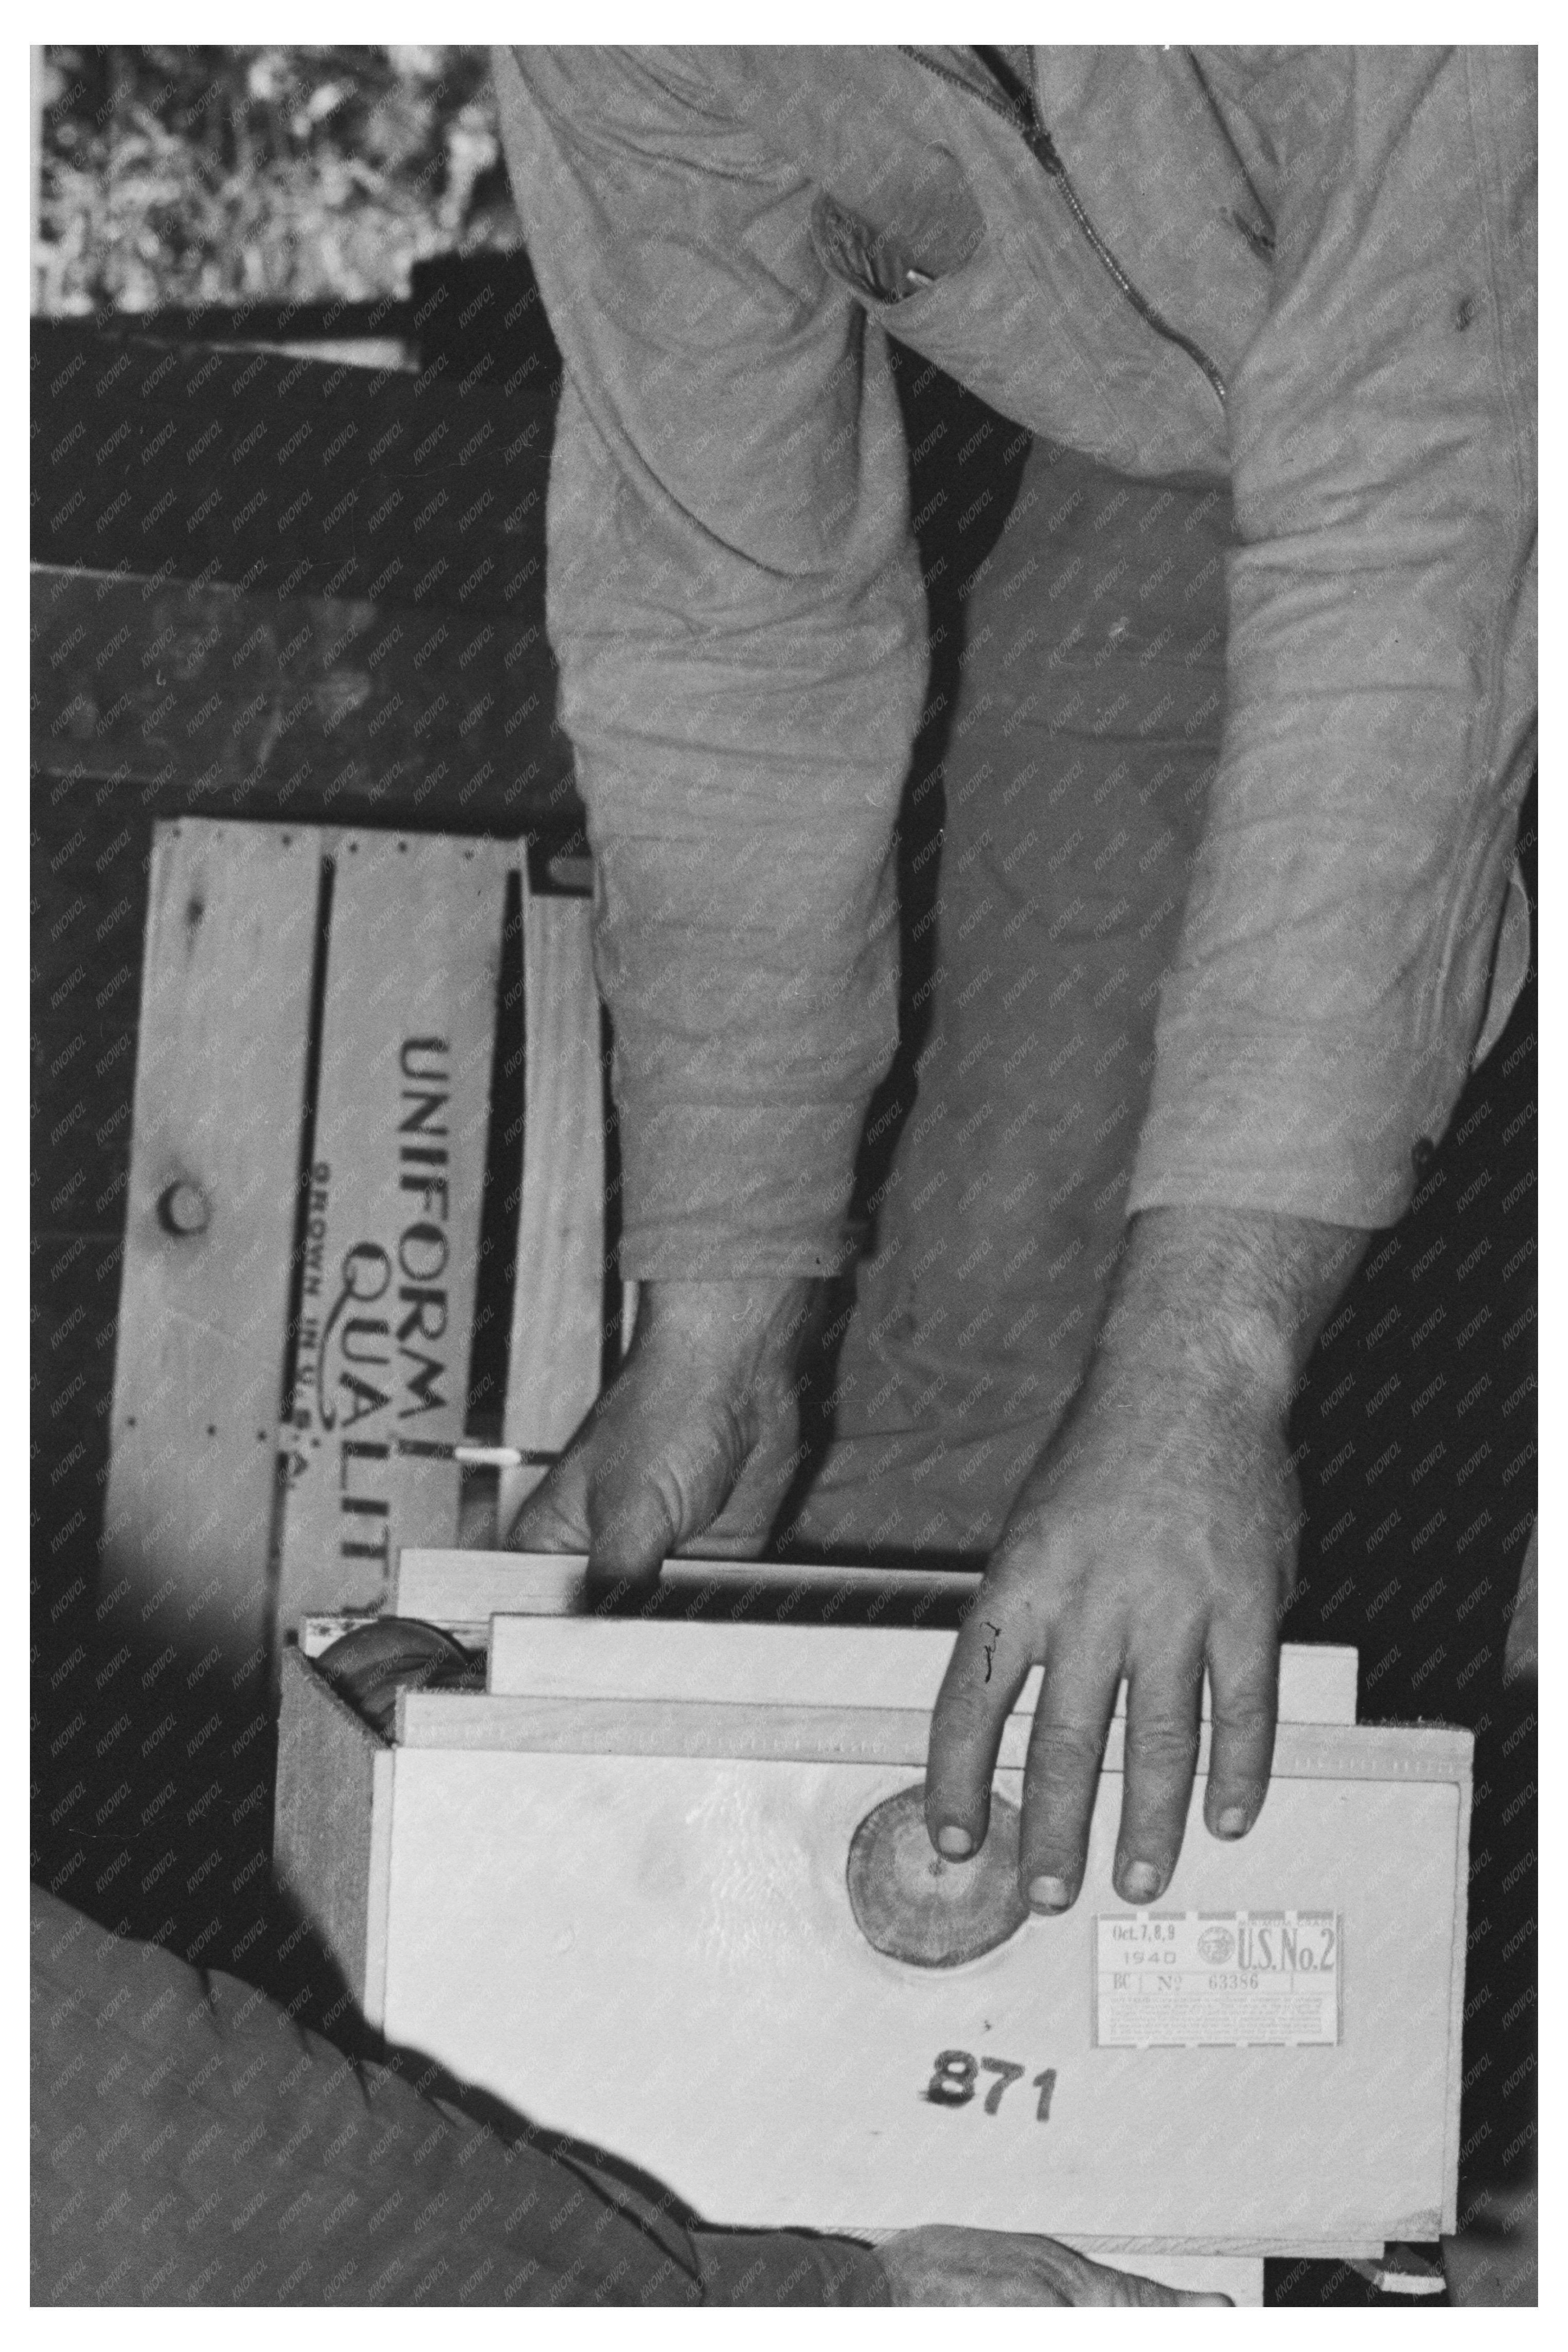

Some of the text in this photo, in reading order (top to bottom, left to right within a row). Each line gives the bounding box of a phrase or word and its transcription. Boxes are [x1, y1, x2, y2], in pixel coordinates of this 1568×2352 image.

[396, 1037, 450, 1419] UNIFORM
[1123, 1951, 1177, 1965] 1940
[1209, 1972, 1259, 1989] 63386
[927, 2049, 1057, 2123] 871
